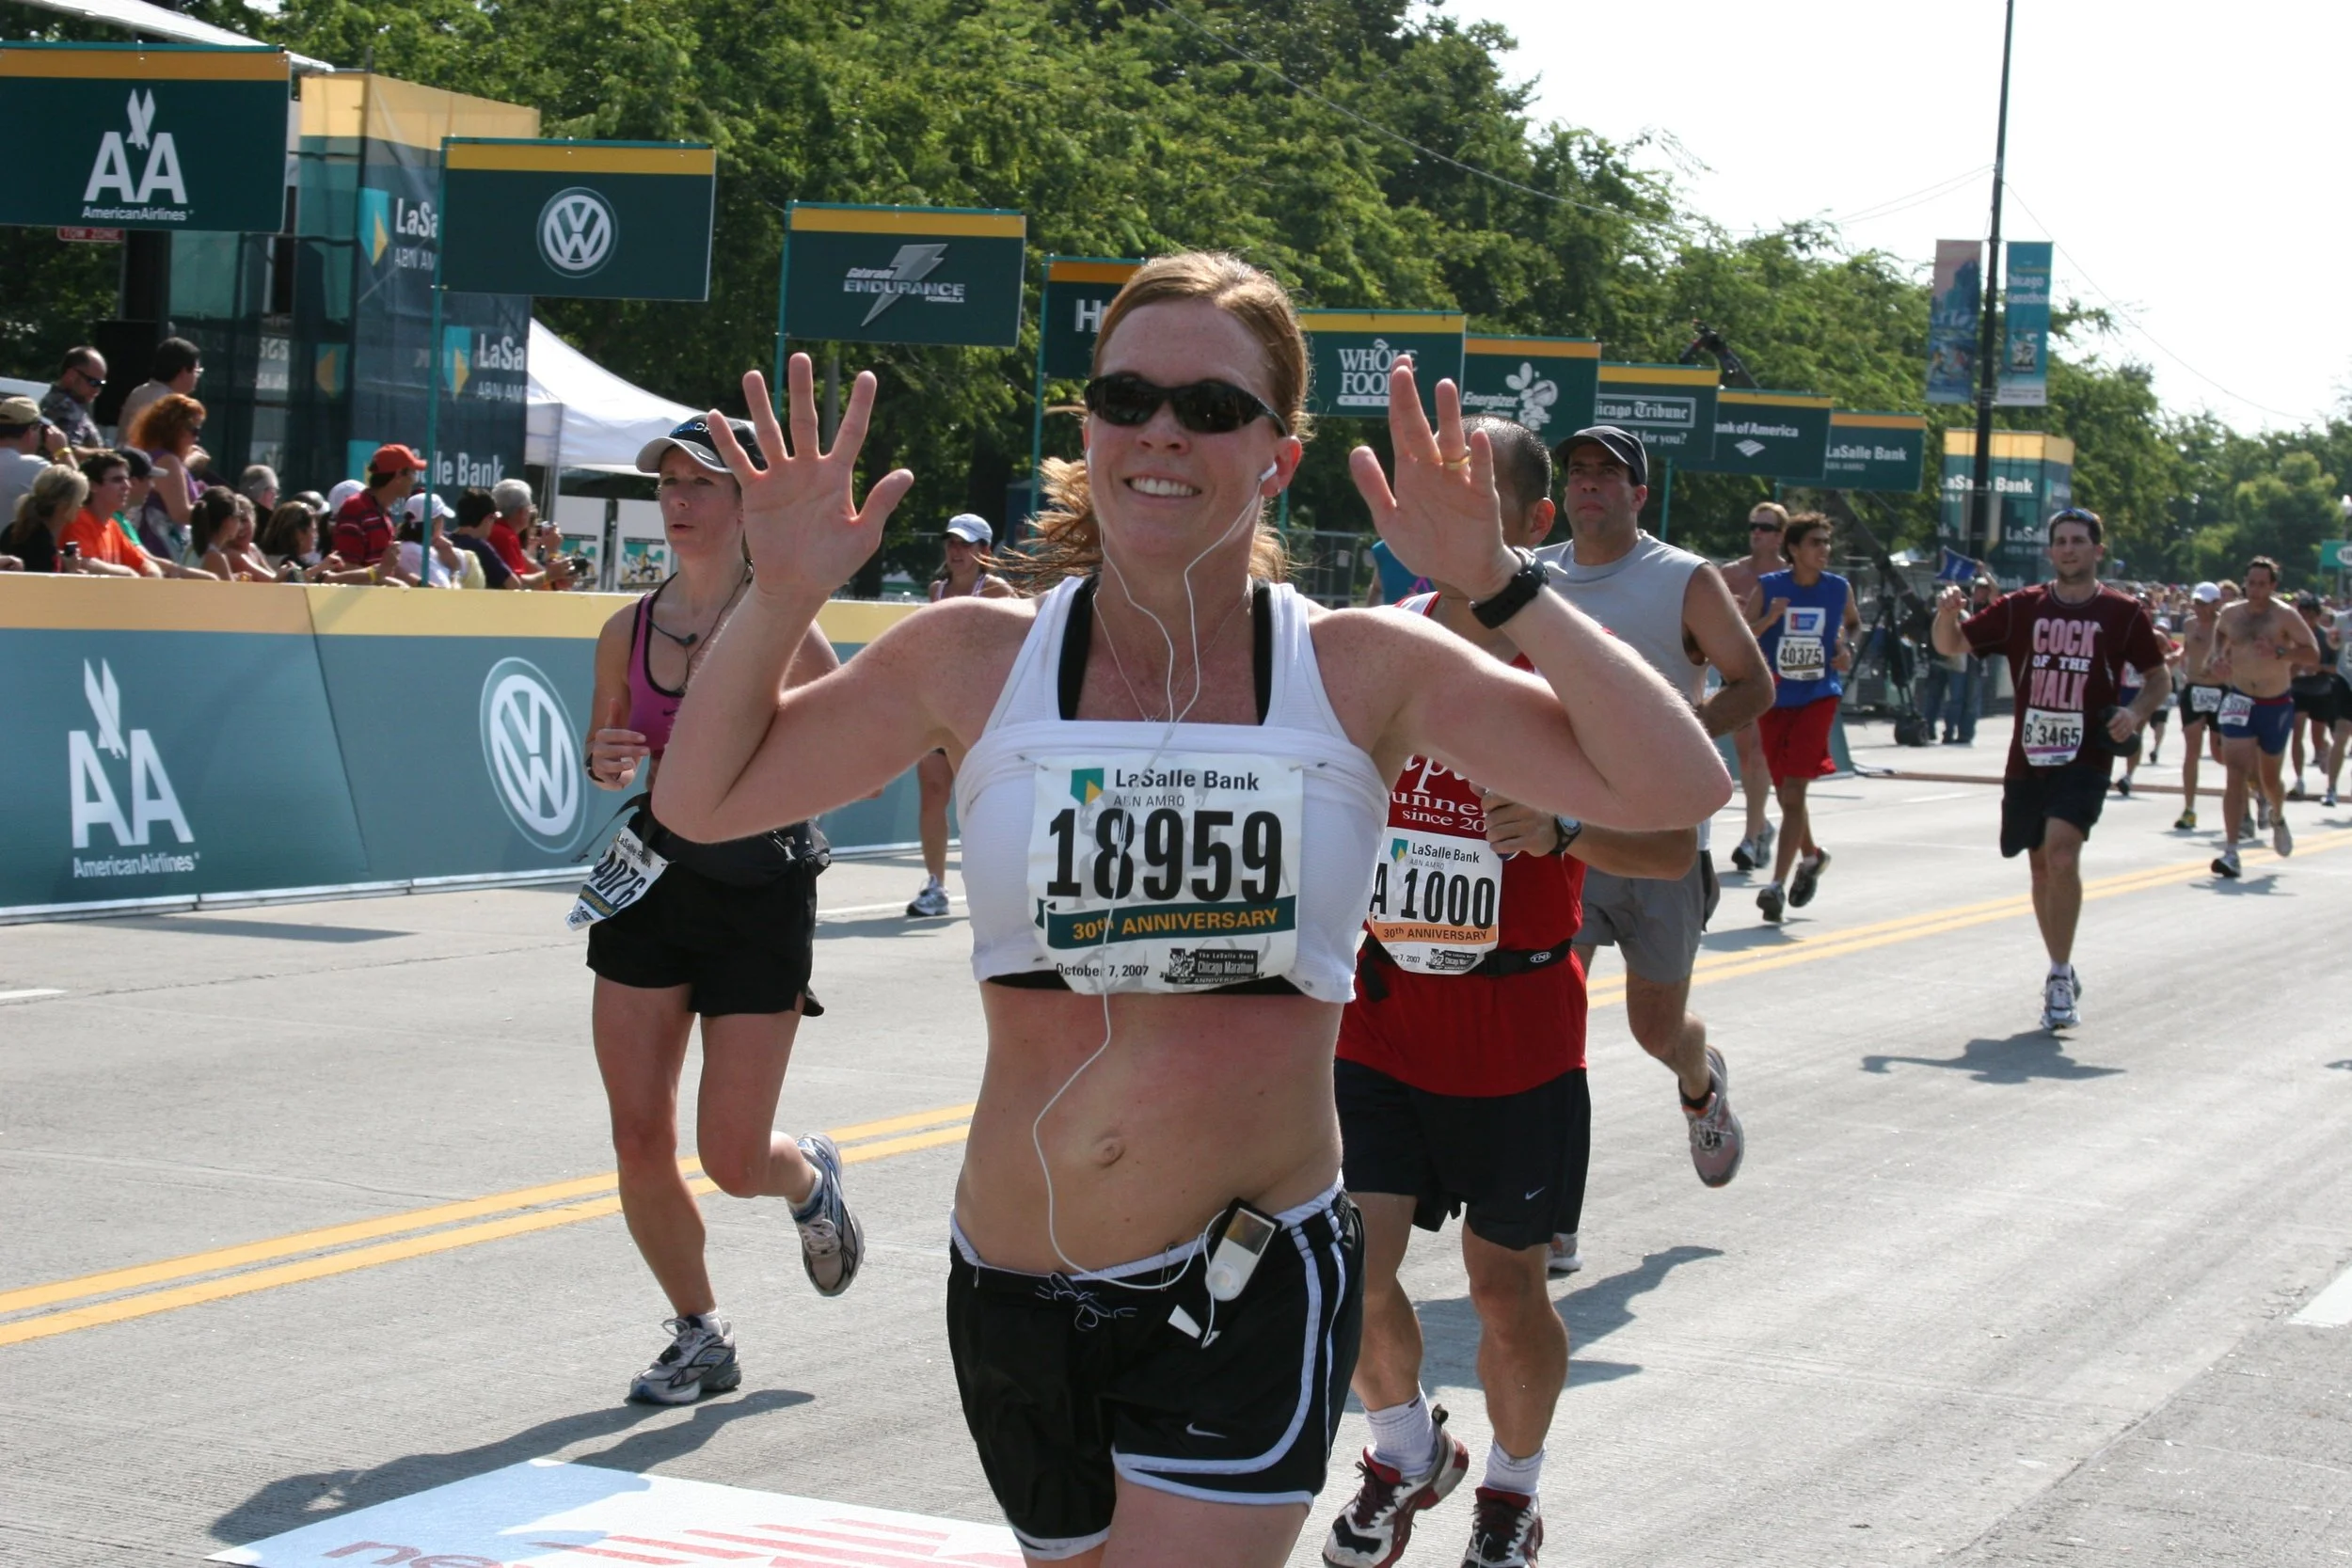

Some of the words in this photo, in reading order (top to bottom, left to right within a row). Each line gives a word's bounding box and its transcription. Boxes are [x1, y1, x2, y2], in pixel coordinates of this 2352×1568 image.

[83, 131, 188, 204] AA
[82, 206, 187, 221] AmericanAirlines
[843, 279, 966, 296] ENDURANCE
[1075, 298, 1107, 333] H
[1634, 400, 1689, 420] Tribune
[1640, 430, 1659, 444] for
[1660, 432, 1688, 447] you?
[1737, 422, 1750, 435] of
[1751, 422, 1799, 438] America
[1826, 444, 1872, 460] LaSalle
[1874, 446, 1907, 461] Bank
[456, 451, 505, 488] Bank
[1994, 475, 2034, 494] Bank
[2032, 618, 2097, 657] COCK
[1780, 647, 1822, 665] 40375
[2032, 655, 2051, 668] OF
[2058, 657, 2091, 672] THE
[2029, 669, 2089, 711] WALK
[2025, 723, 2033, 744] B
[2037, 724, 2082, 747] 3465
[69, 729, 195, 848] AA
[1115, 768, 1196, 788] LaSalle
[1203, 770, 1260, 791] Bank
[1145, 796, 1185, 807] AMRO
[1402, 807, 1454, 827] since
[1047, 807, 1283, 906] 18959
[1412, 843, 1452, 860] LaSalle
[1454, 849, 1481, 864] Bank
[73, 852, 196, 879] AmericanAirlines
[1410, 858, 1423, 867] ABN
[1425, 860, 1445, 871] AMRO
[589, 849, 647, 909] 4076
[1400, 867, 1496, 929] 1000
[1073, 915, 1115, 941] 30th
[1121, 908, 1279, 935] ANNIVERSARY
[1383, 927, 1405, 939] 30th
[1406, 928, 1488, 942] ANNIVERSARY
[1198, 960, 1223, 975] Chicago
[1224, 960, 1255, 974] Marathon
[1406, 954, 1422, 964] 2007
[1108, 964, 1119, 980] 7,
[1121, 965, 1150, 978] 2007
